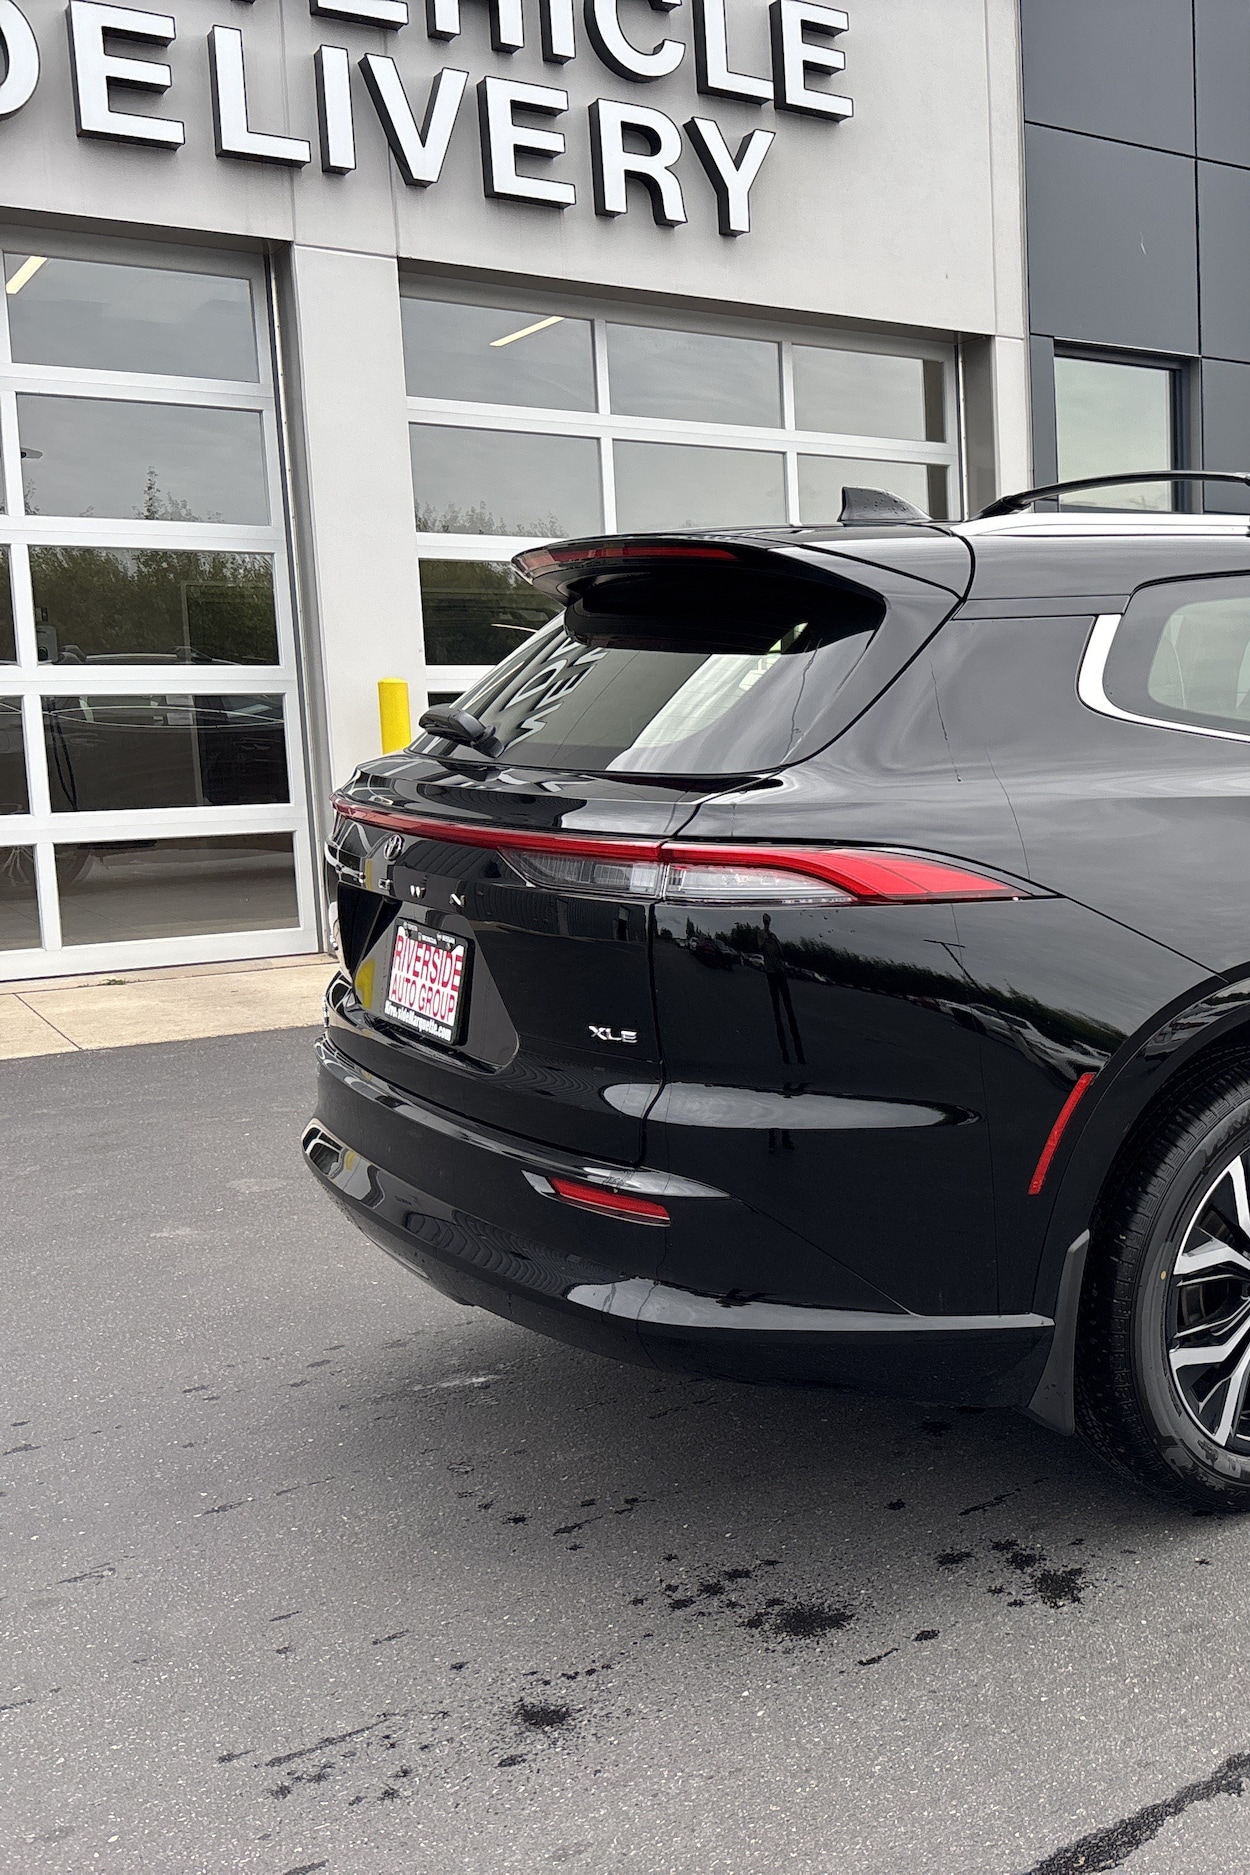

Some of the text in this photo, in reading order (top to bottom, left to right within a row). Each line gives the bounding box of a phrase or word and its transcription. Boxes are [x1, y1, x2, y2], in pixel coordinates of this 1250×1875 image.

[230, 0, 853, 124] ICLE
[393, 934, 463, 992] RIVERSIDE
[391, 973, 455, 1022] AUTO GROUP
[588, 1025, 638, 1044] XLE
